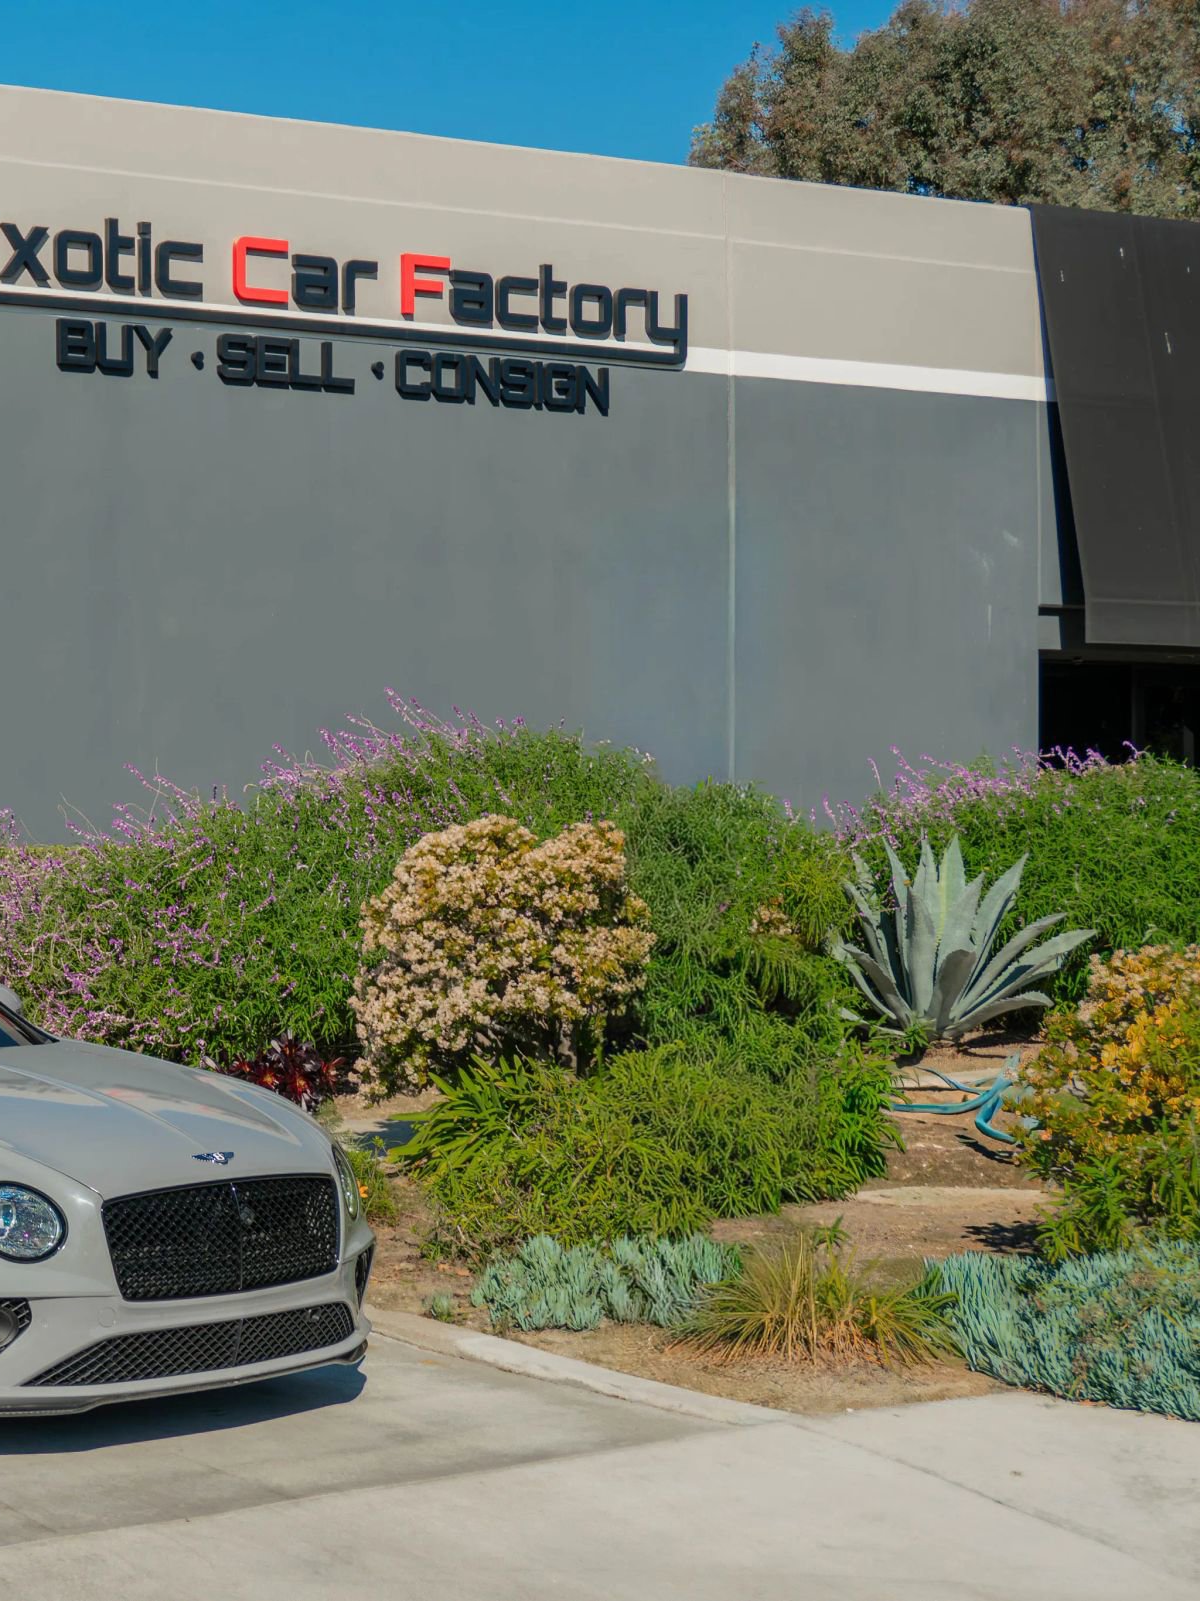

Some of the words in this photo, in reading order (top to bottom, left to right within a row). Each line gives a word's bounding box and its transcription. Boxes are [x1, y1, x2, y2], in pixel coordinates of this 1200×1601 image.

[232, 235, 379, 313] Car
[400, 253, 689, 364] Factory
[56, 318, 173, 378] BUY
[217, 333, 356, 394] SELL
[395, 349, 610, 416] CONSIGN
